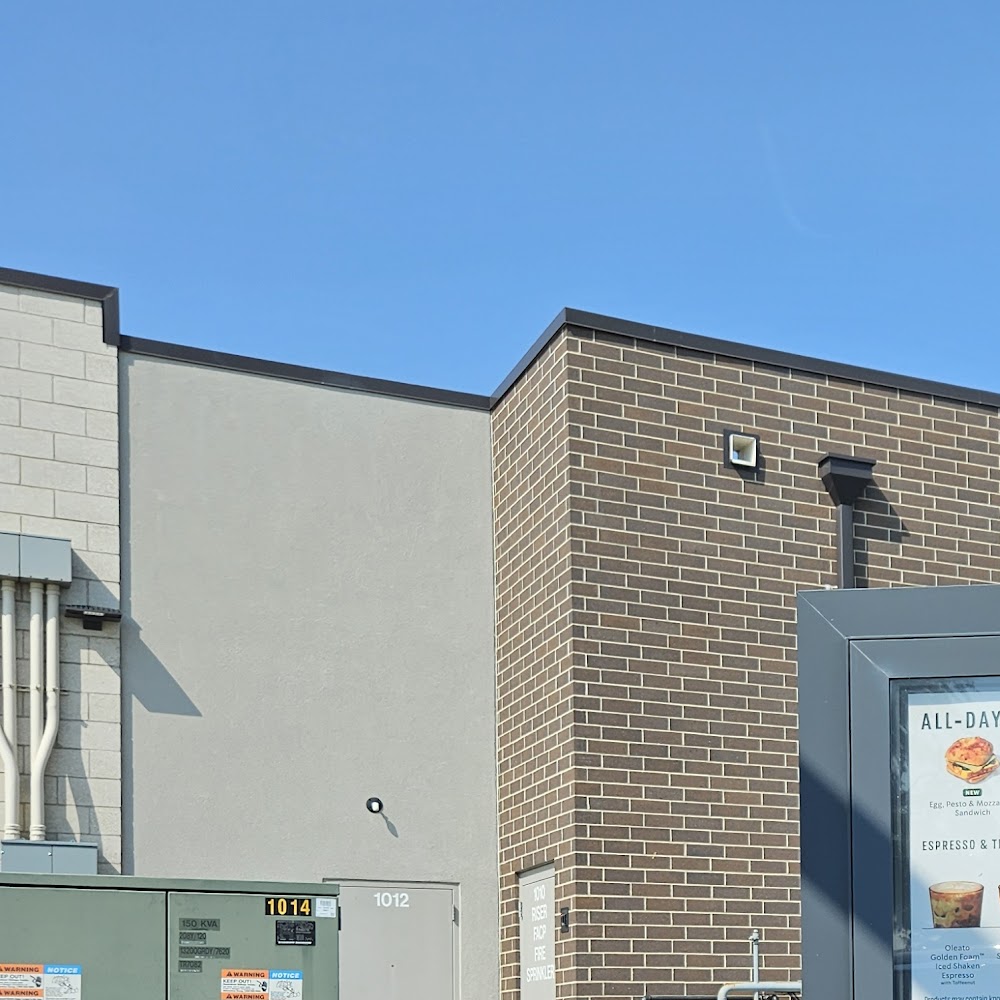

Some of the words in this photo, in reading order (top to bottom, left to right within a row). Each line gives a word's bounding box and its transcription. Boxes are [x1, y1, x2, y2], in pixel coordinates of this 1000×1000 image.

[929, 801, 944, 809] Egg,
[946, 800, 967, 808] Pesto
[955, 808, 991, 816] Sandwich
[922, 839, 976, 851] ESPRESSO
[980, 839, 988, 850] &
[533, 884, 546, 901] 1010
[373, 892, 410, 908] 1012
[267, 898, 311, 916] 1014
[531, 904, 548, 922] RISER
[182, 920, 197, 928] 150
[200, 920, 218, 928] KVA
[534, 945, 546, 961] FIRE
[945, 944, 970, 952] Oleato
[930, 953, 958, 961] Golden
[953, 962, 981, 970] Shaken
[526, 964, 555, 983] SPRINKLER
[942, 972, 975, 980] Espresso
